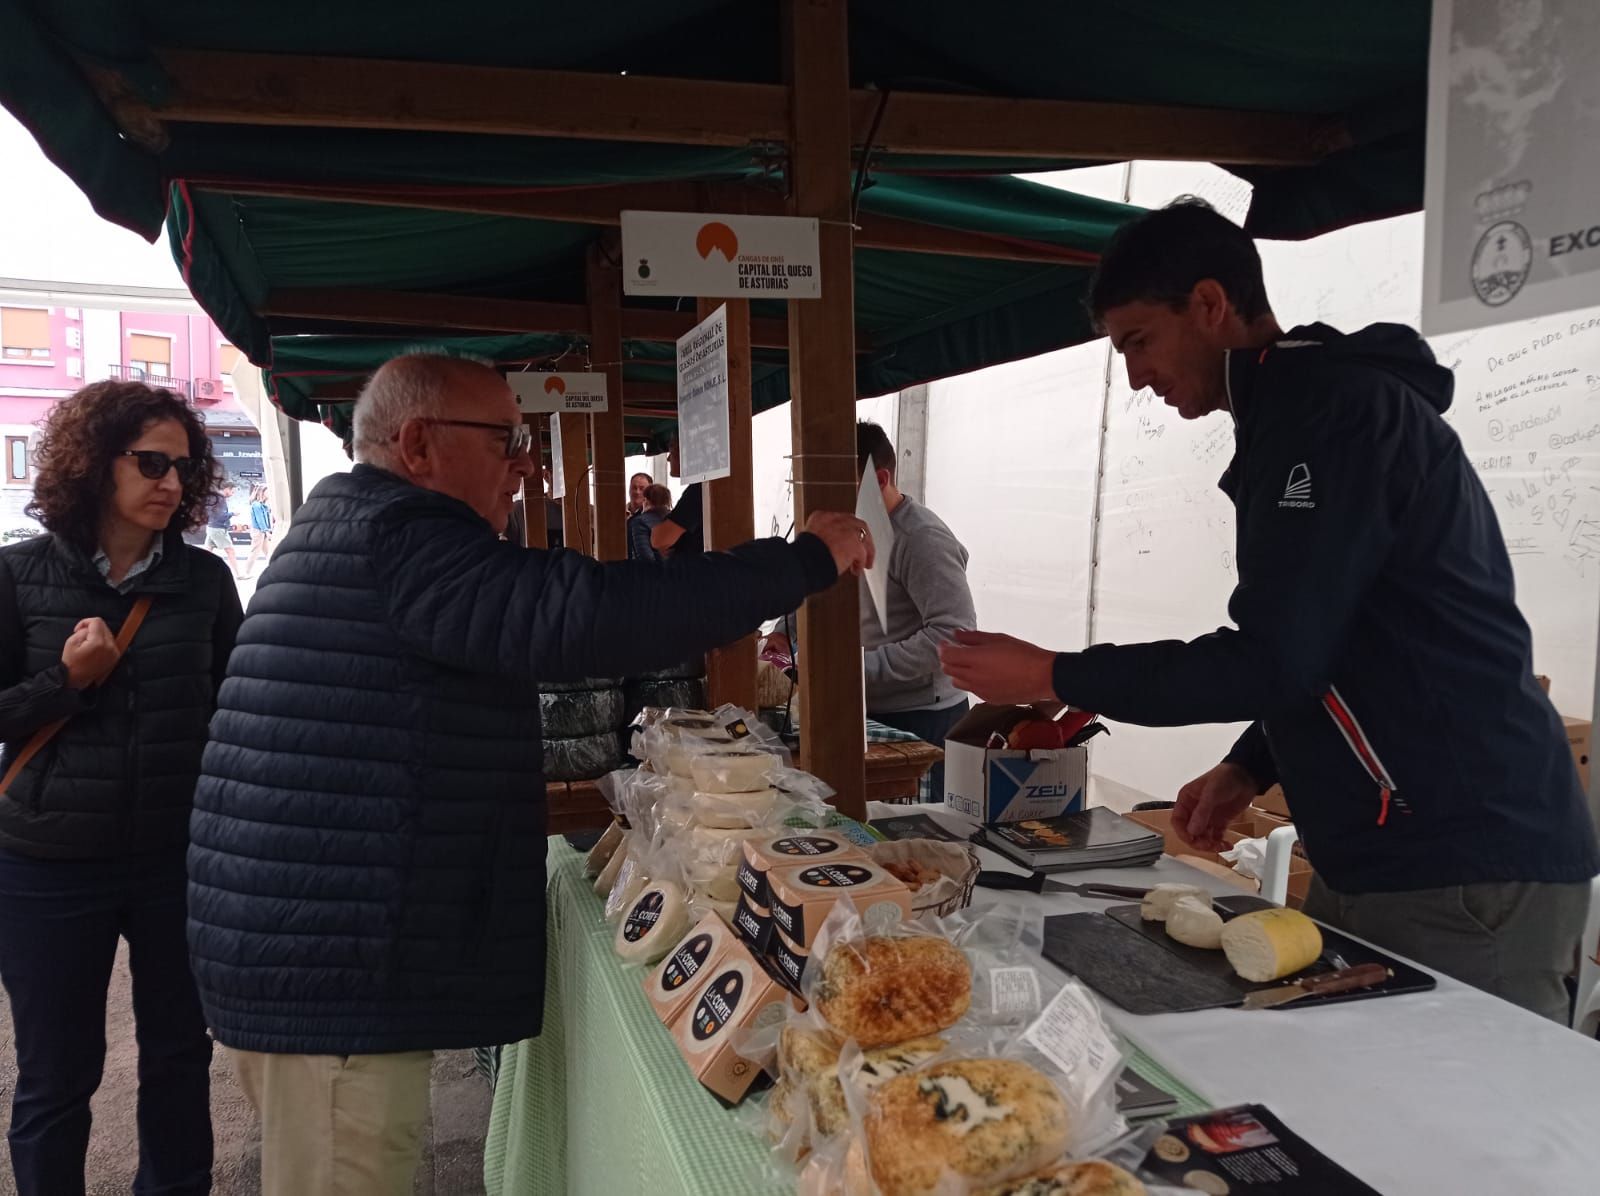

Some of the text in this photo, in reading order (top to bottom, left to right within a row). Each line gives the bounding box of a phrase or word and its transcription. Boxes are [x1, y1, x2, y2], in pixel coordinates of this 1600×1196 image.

[738, 263, 813, 277] CAPITAL DEL QUESO
[739, 276, 789, 289] DE ASTURIAS
[744, 870, 758, 890] CORTE
[829, 870, 854, 885] CORTE
[639, 910, 660, 922] CORTE
[745, 914, 760, 936] CORTE
[777, 906, 792, 929] CORTE
[682, 953, 699, 975] CORTE
[783, 954, 800, 977] CORTE
[712, 994, 731, 1021] CORTE
